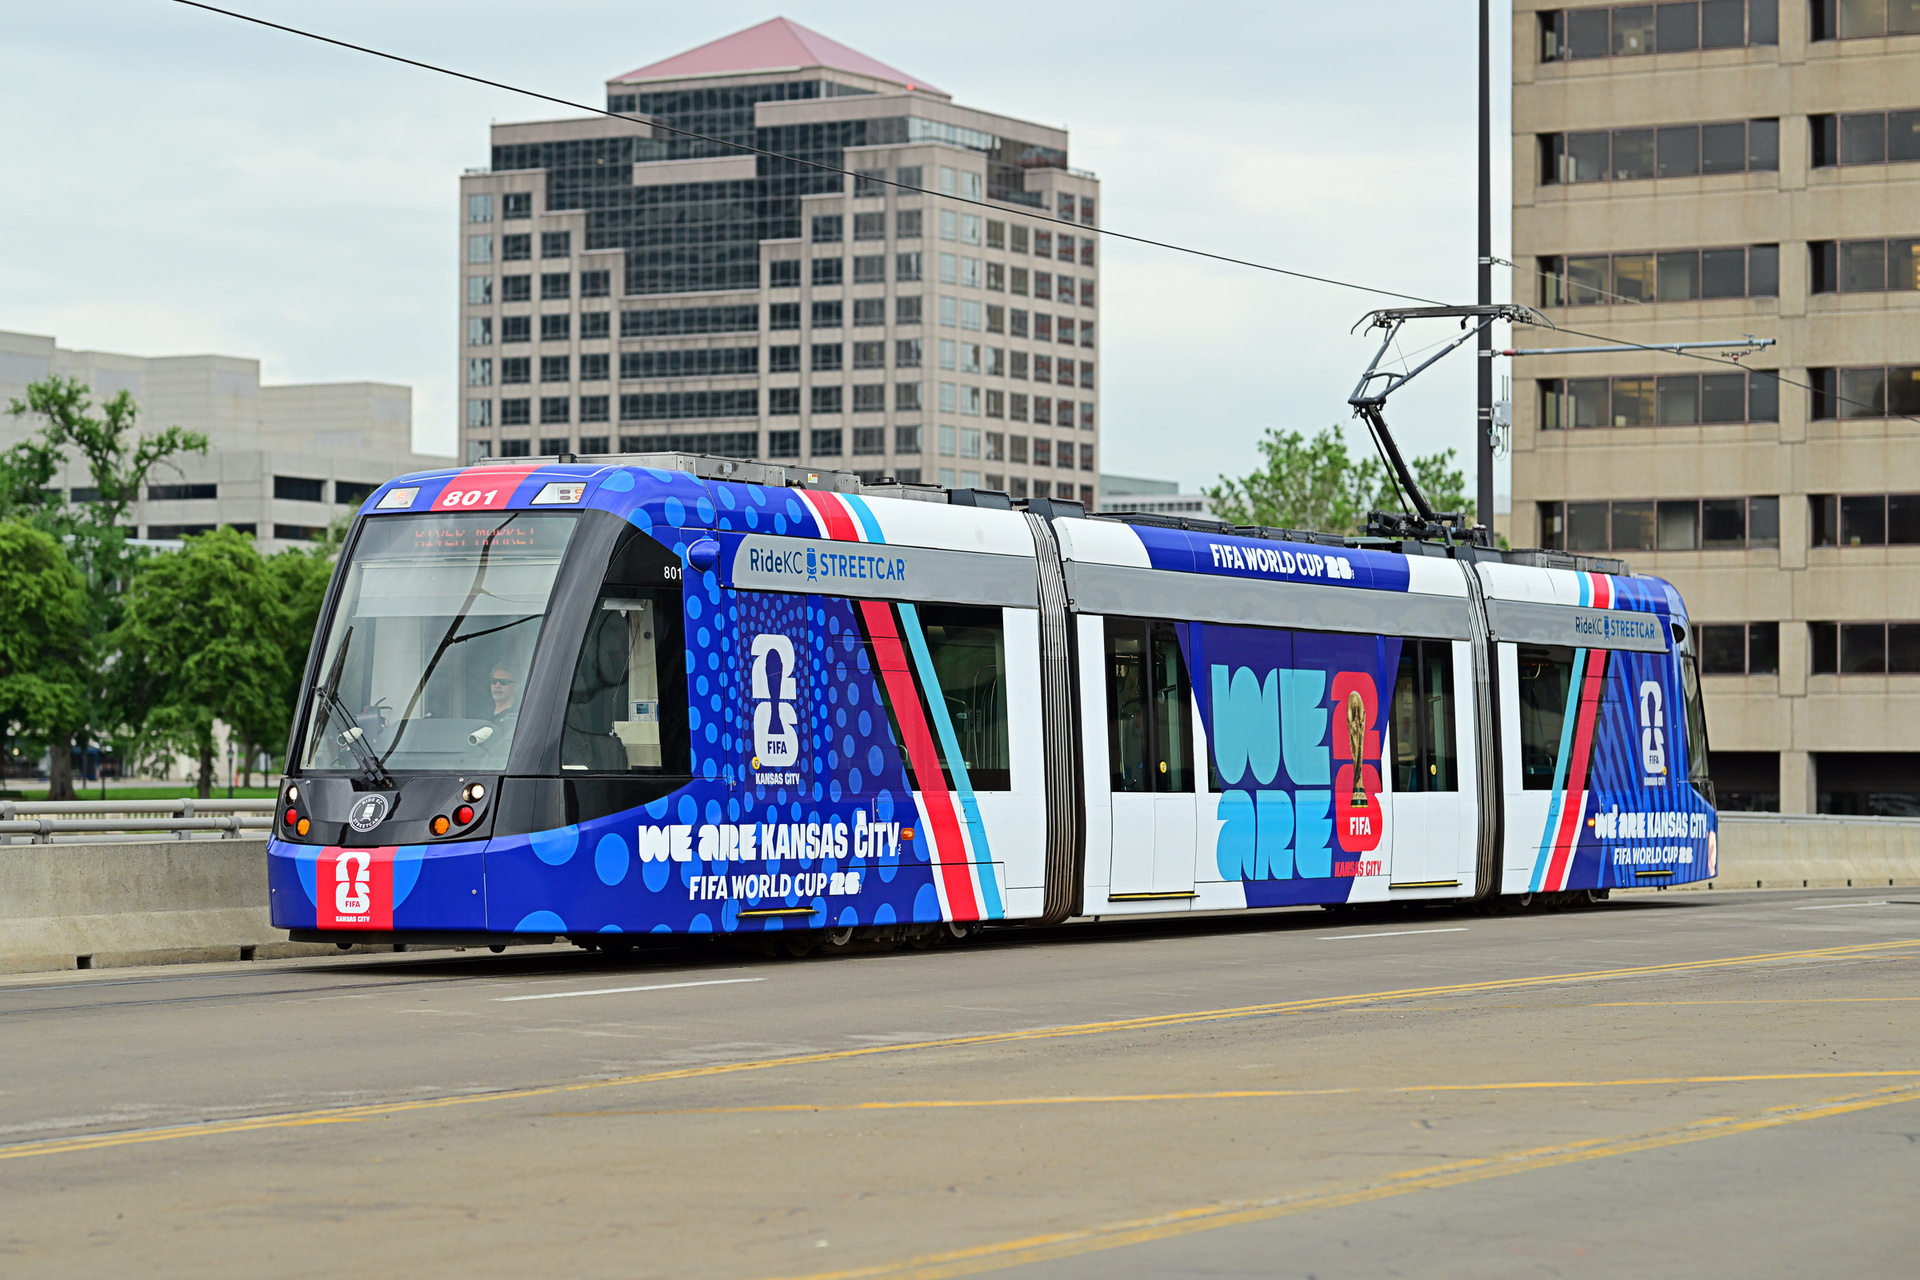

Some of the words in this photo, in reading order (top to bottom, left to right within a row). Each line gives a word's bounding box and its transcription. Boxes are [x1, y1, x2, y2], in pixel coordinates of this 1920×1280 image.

[442, 489, 498, 506] 801
[750, 548, 803, 574] RideKC
[820, 553, 905, 581] STREETCAR
[1209, 543, 1245, 570] FIFA
[1241, 547, 1296, 574] WORLD
[1296, 552, 1324, 577] CUP
[1324, 555, 1352, 580] 26
[664, 566, 682, 580] 801
[1575, 616, 1602, 635] RideKC
[1611, 619, 1655, 639] STREETCAR
[767, 741, 787, 754] FIFA
[1649, 755, 1659, 764] FIFA
[755, 772, 783, 785] KANSAS
[785, 772, 800, 785] CITY
[1349, 816, 1372, 836] FIFA
[1647, 811, 1688, 839] KANSAS
[1690, 813, 1707, 839] CITY
[638, 825, 692, 862] WE
[761, 822, 848, 860] KANSAS
[854, 822, 900, 858] CITY
[1613, 847, 1632, 865] FIFA
[1632, 846, 1661, 864] WORLD
[1662, 846, 1679, 864] CUP
[1334, 860, 1363, 877] KANSAS
[1366, 860, 1382, 877] CITY
[689, 876, 728, 900] FIFA
[732, 873, 793, 899] WORLD
[794, 873, 827, 897] CUP
[829, 872, 860, 895] 26
[345, 900, 361, 908] FIFA
